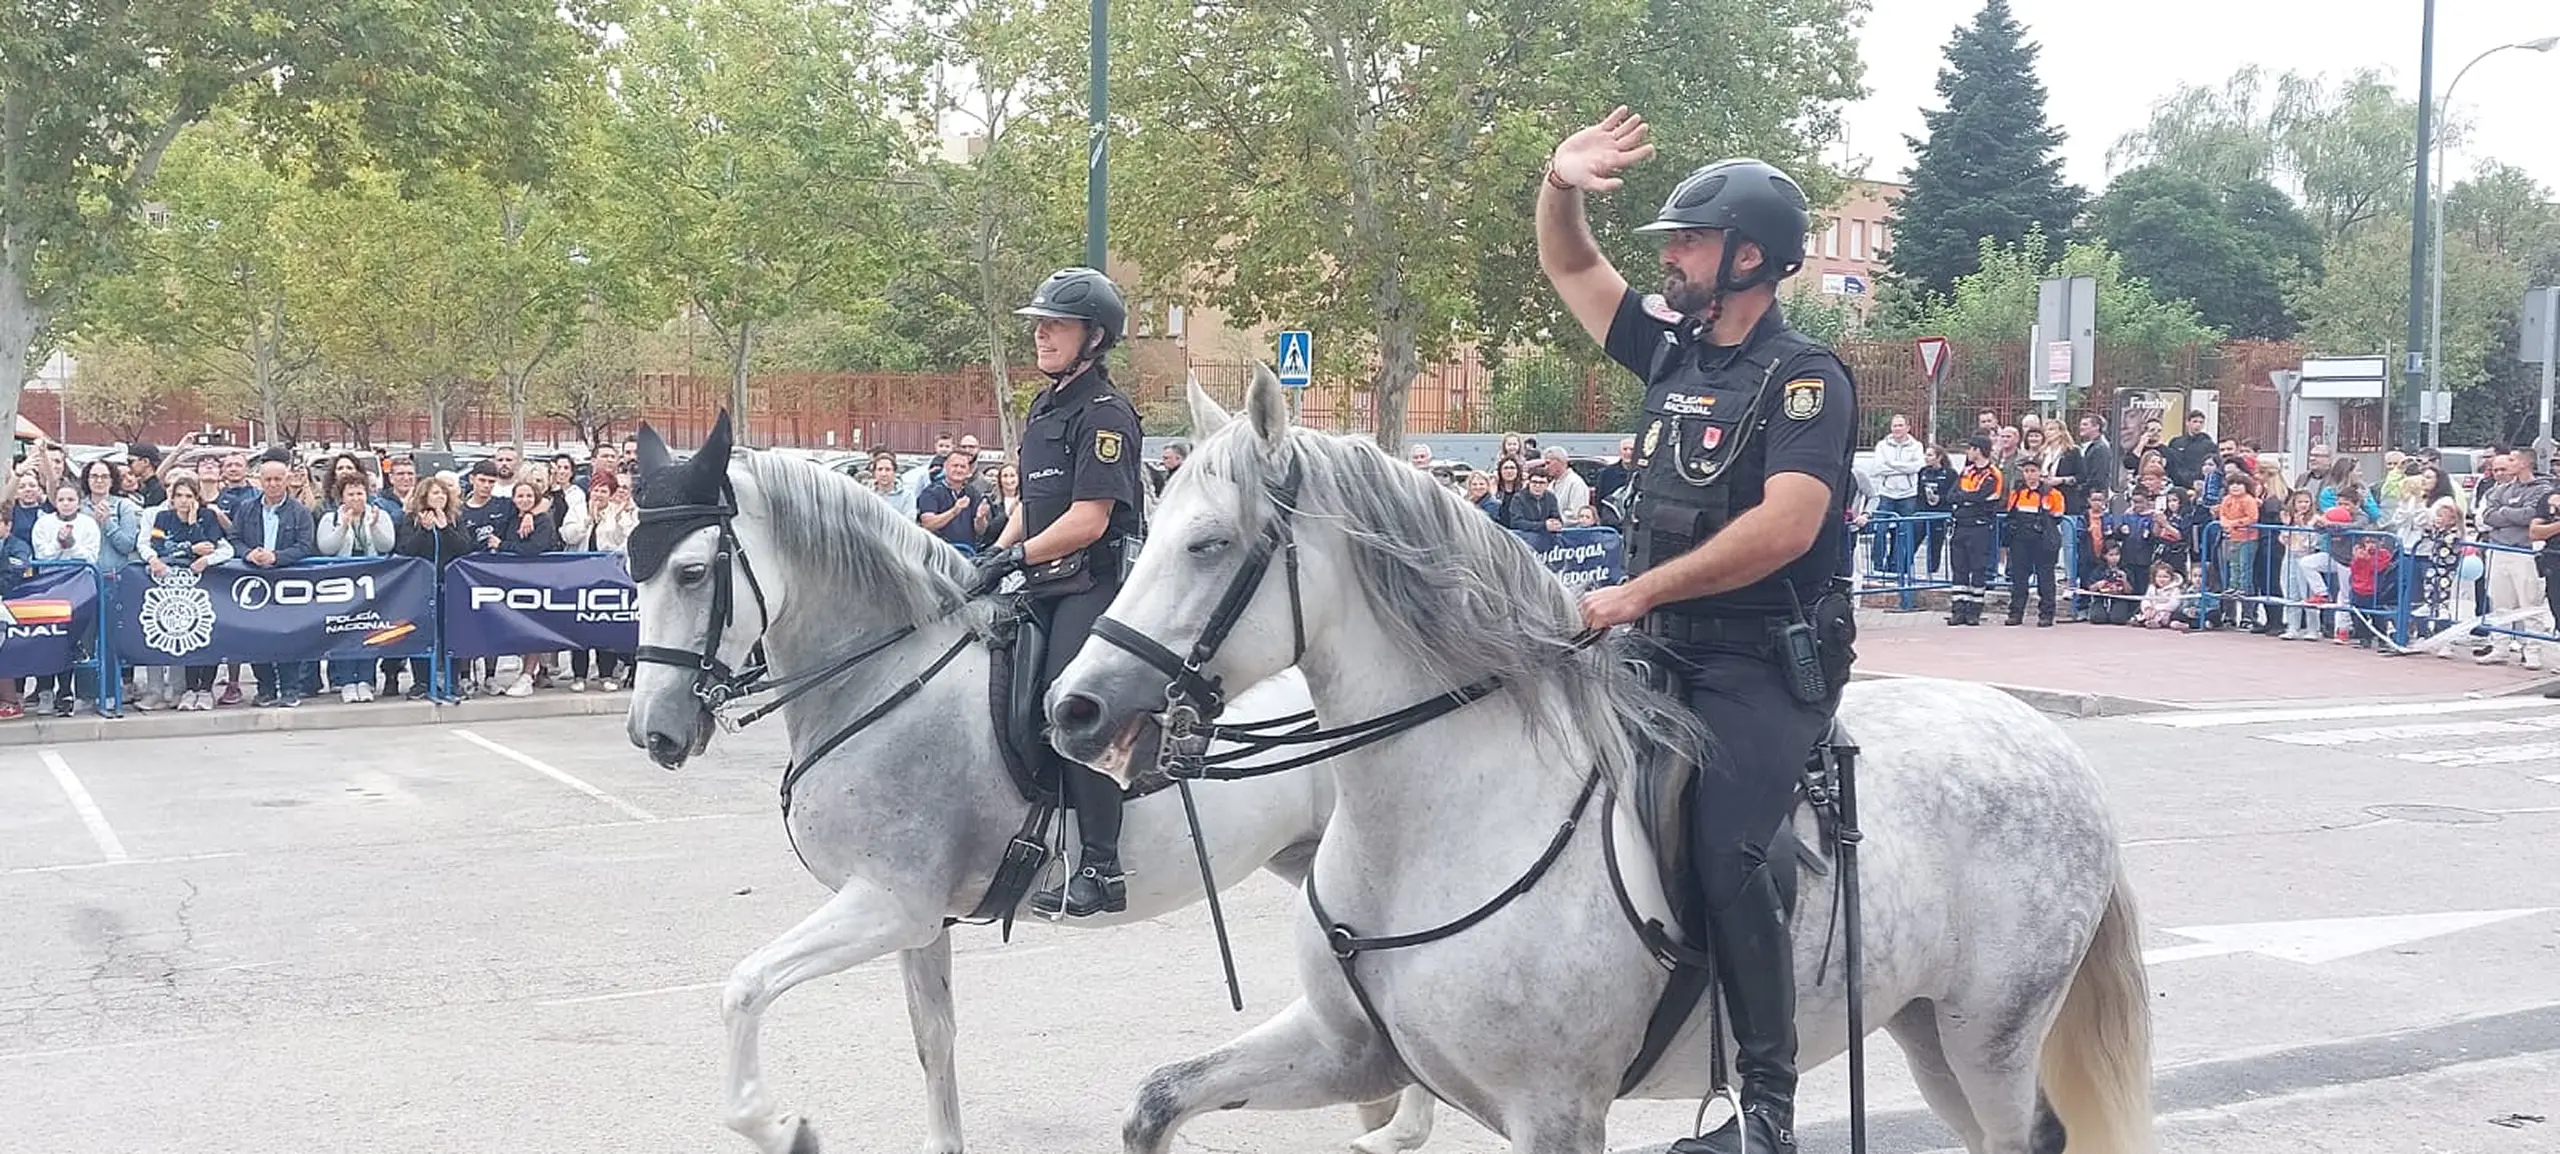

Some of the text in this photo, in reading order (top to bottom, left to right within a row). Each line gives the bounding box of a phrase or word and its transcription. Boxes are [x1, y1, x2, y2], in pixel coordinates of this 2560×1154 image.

[1663, 401, 1712, 415] NACIONAL
[1548, 542, 1606, 564] drogas,
[275, 575, 376, 604] 091
[325, 621, 398, 634] NACIONAL
